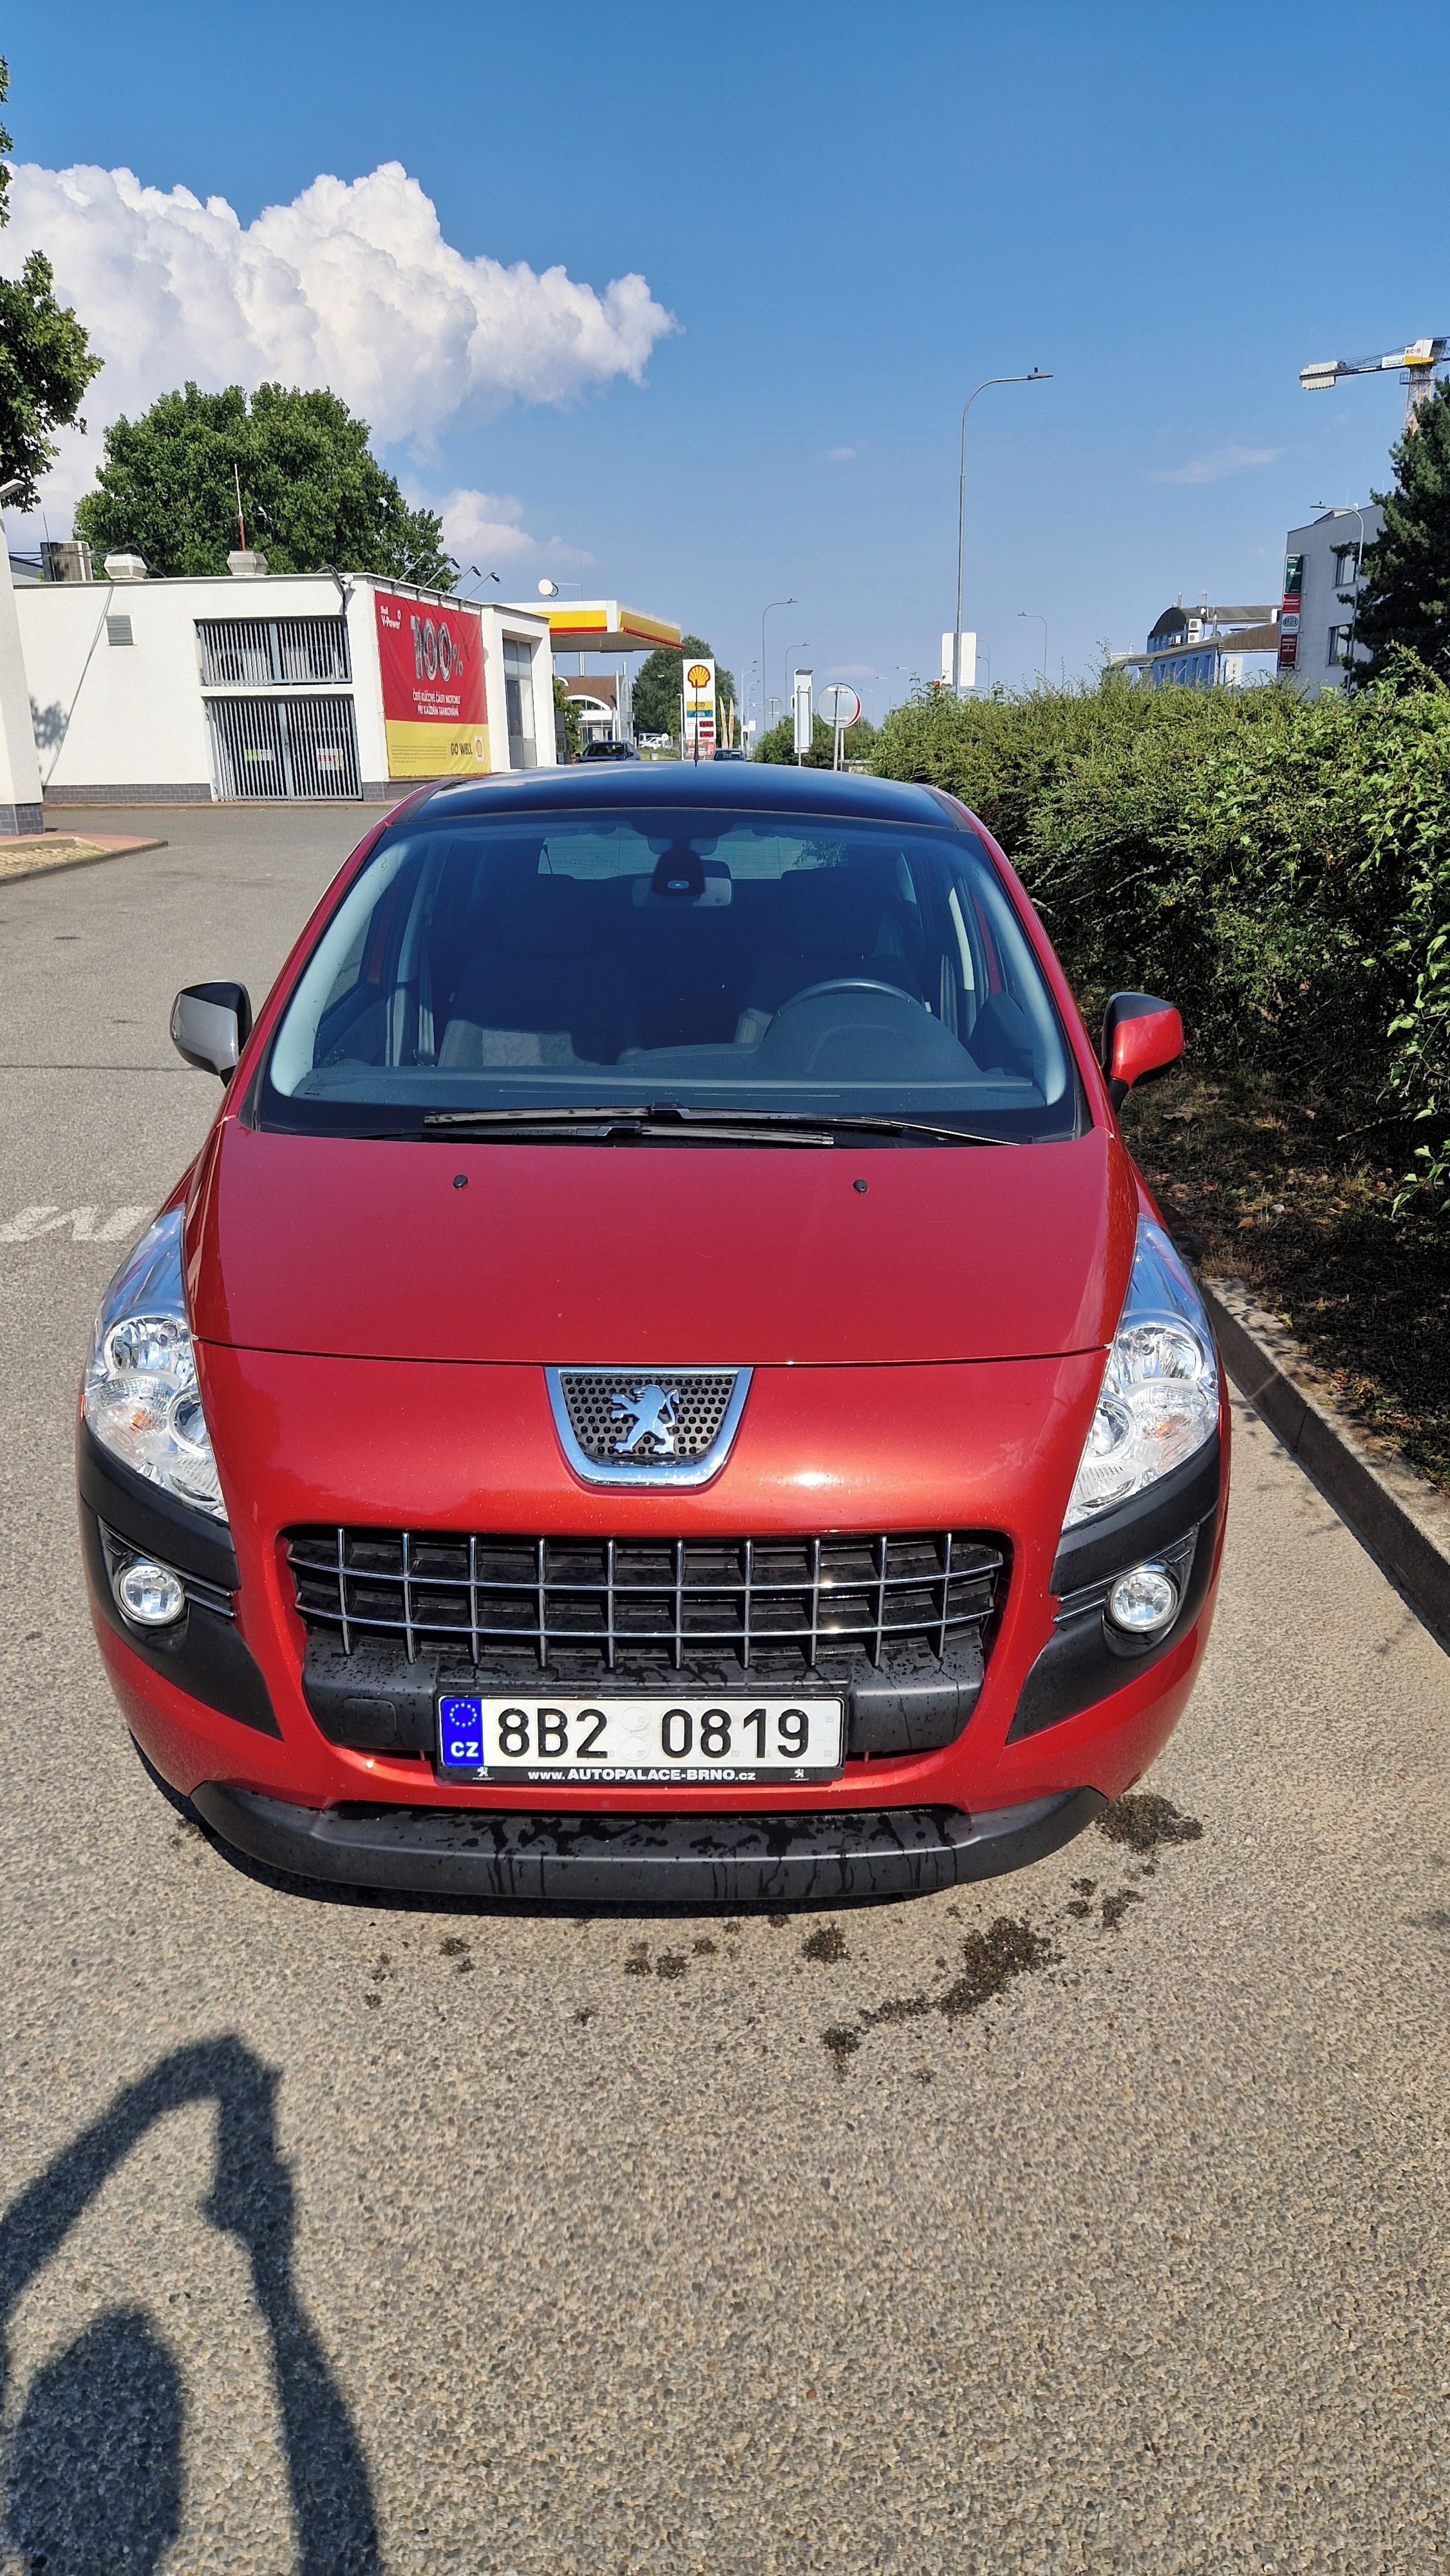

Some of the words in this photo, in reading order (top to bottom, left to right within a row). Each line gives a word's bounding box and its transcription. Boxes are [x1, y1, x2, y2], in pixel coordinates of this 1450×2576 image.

[381, 615, 400, 629] V-Power
[451, 743, 458, 755] GO
[459, 743, 473, 755] WELL
[498, 1708, 608, 1759] 8B2
[661, 1707, 809, 1758] 0819
[451, 1741, 479, 1757] CZ
[527, 1768, 757, 1781] www.AUTOPALACE-BRNO.cz
